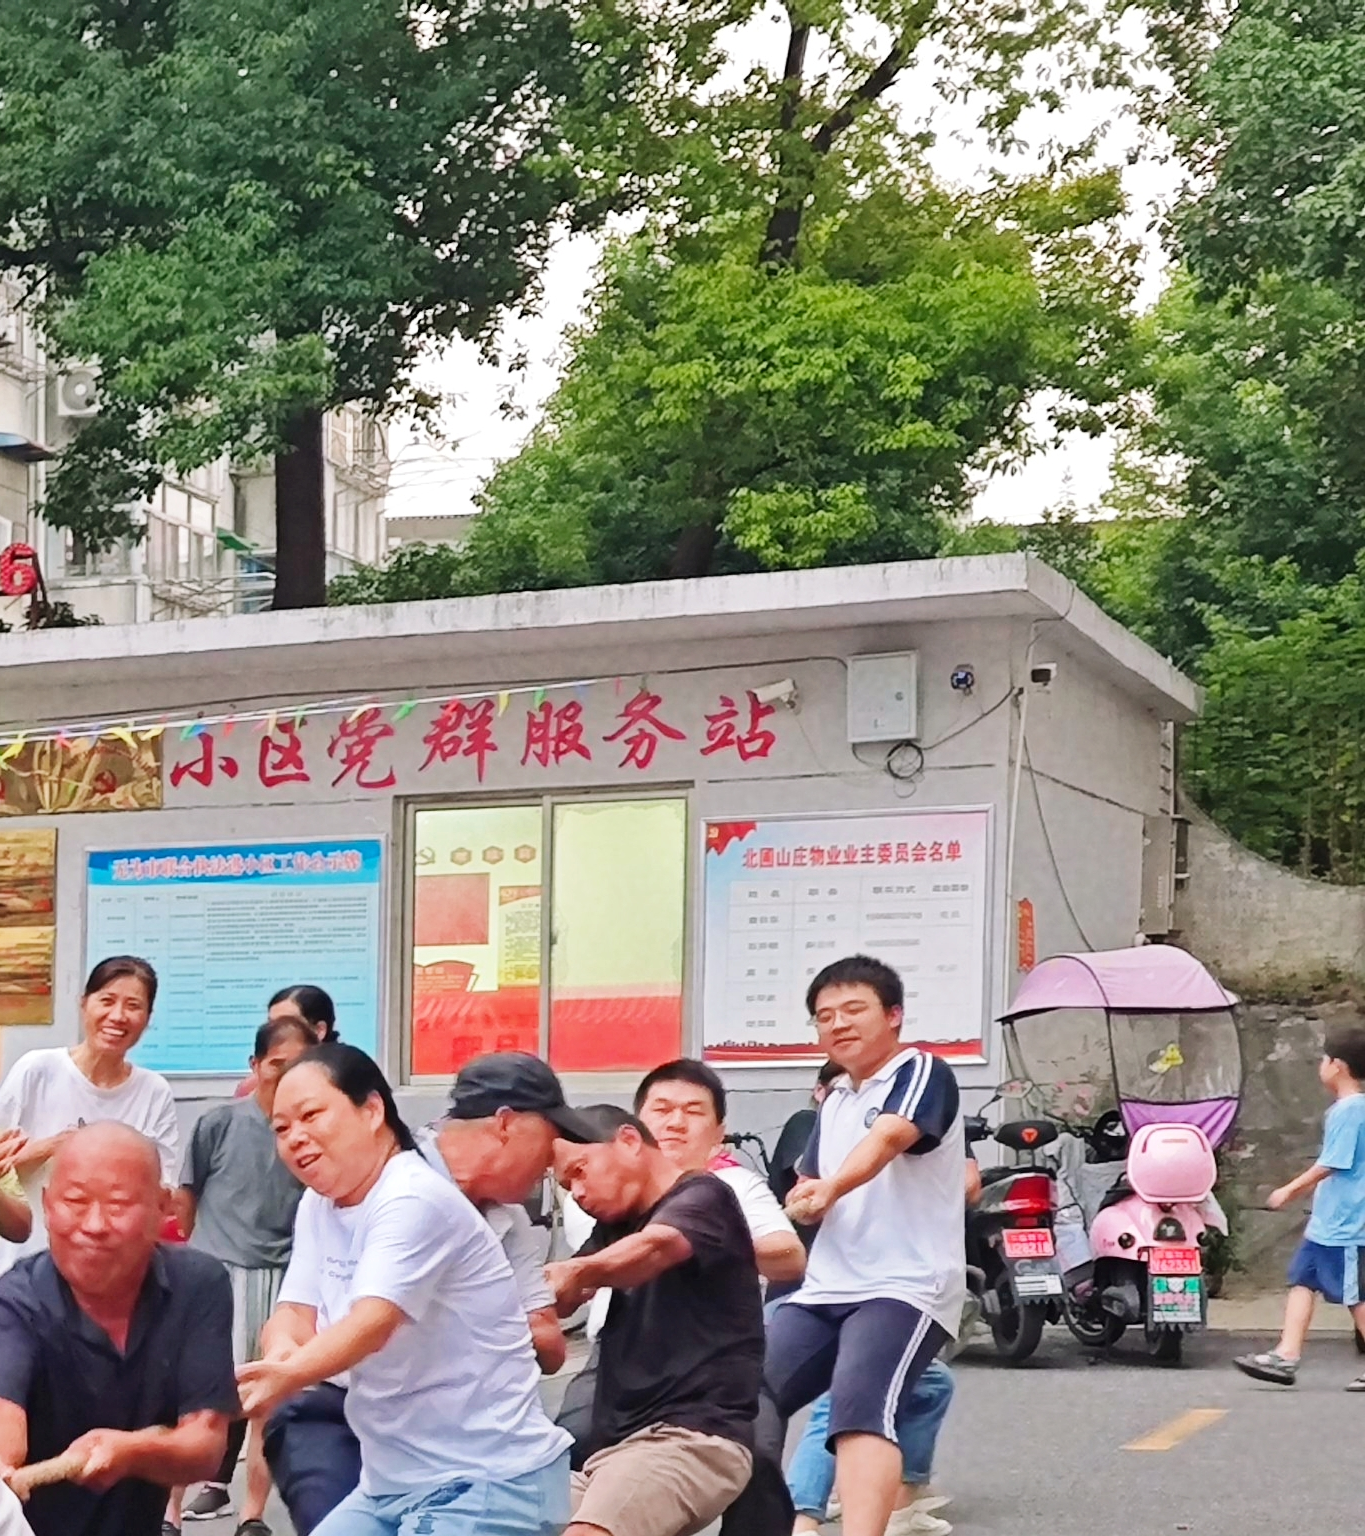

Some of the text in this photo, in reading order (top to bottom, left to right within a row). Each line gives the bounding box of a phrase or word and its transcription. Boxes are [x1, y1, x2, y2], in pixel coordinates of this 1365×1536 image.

[168, 690, 777, 790] 小区党群服务站
